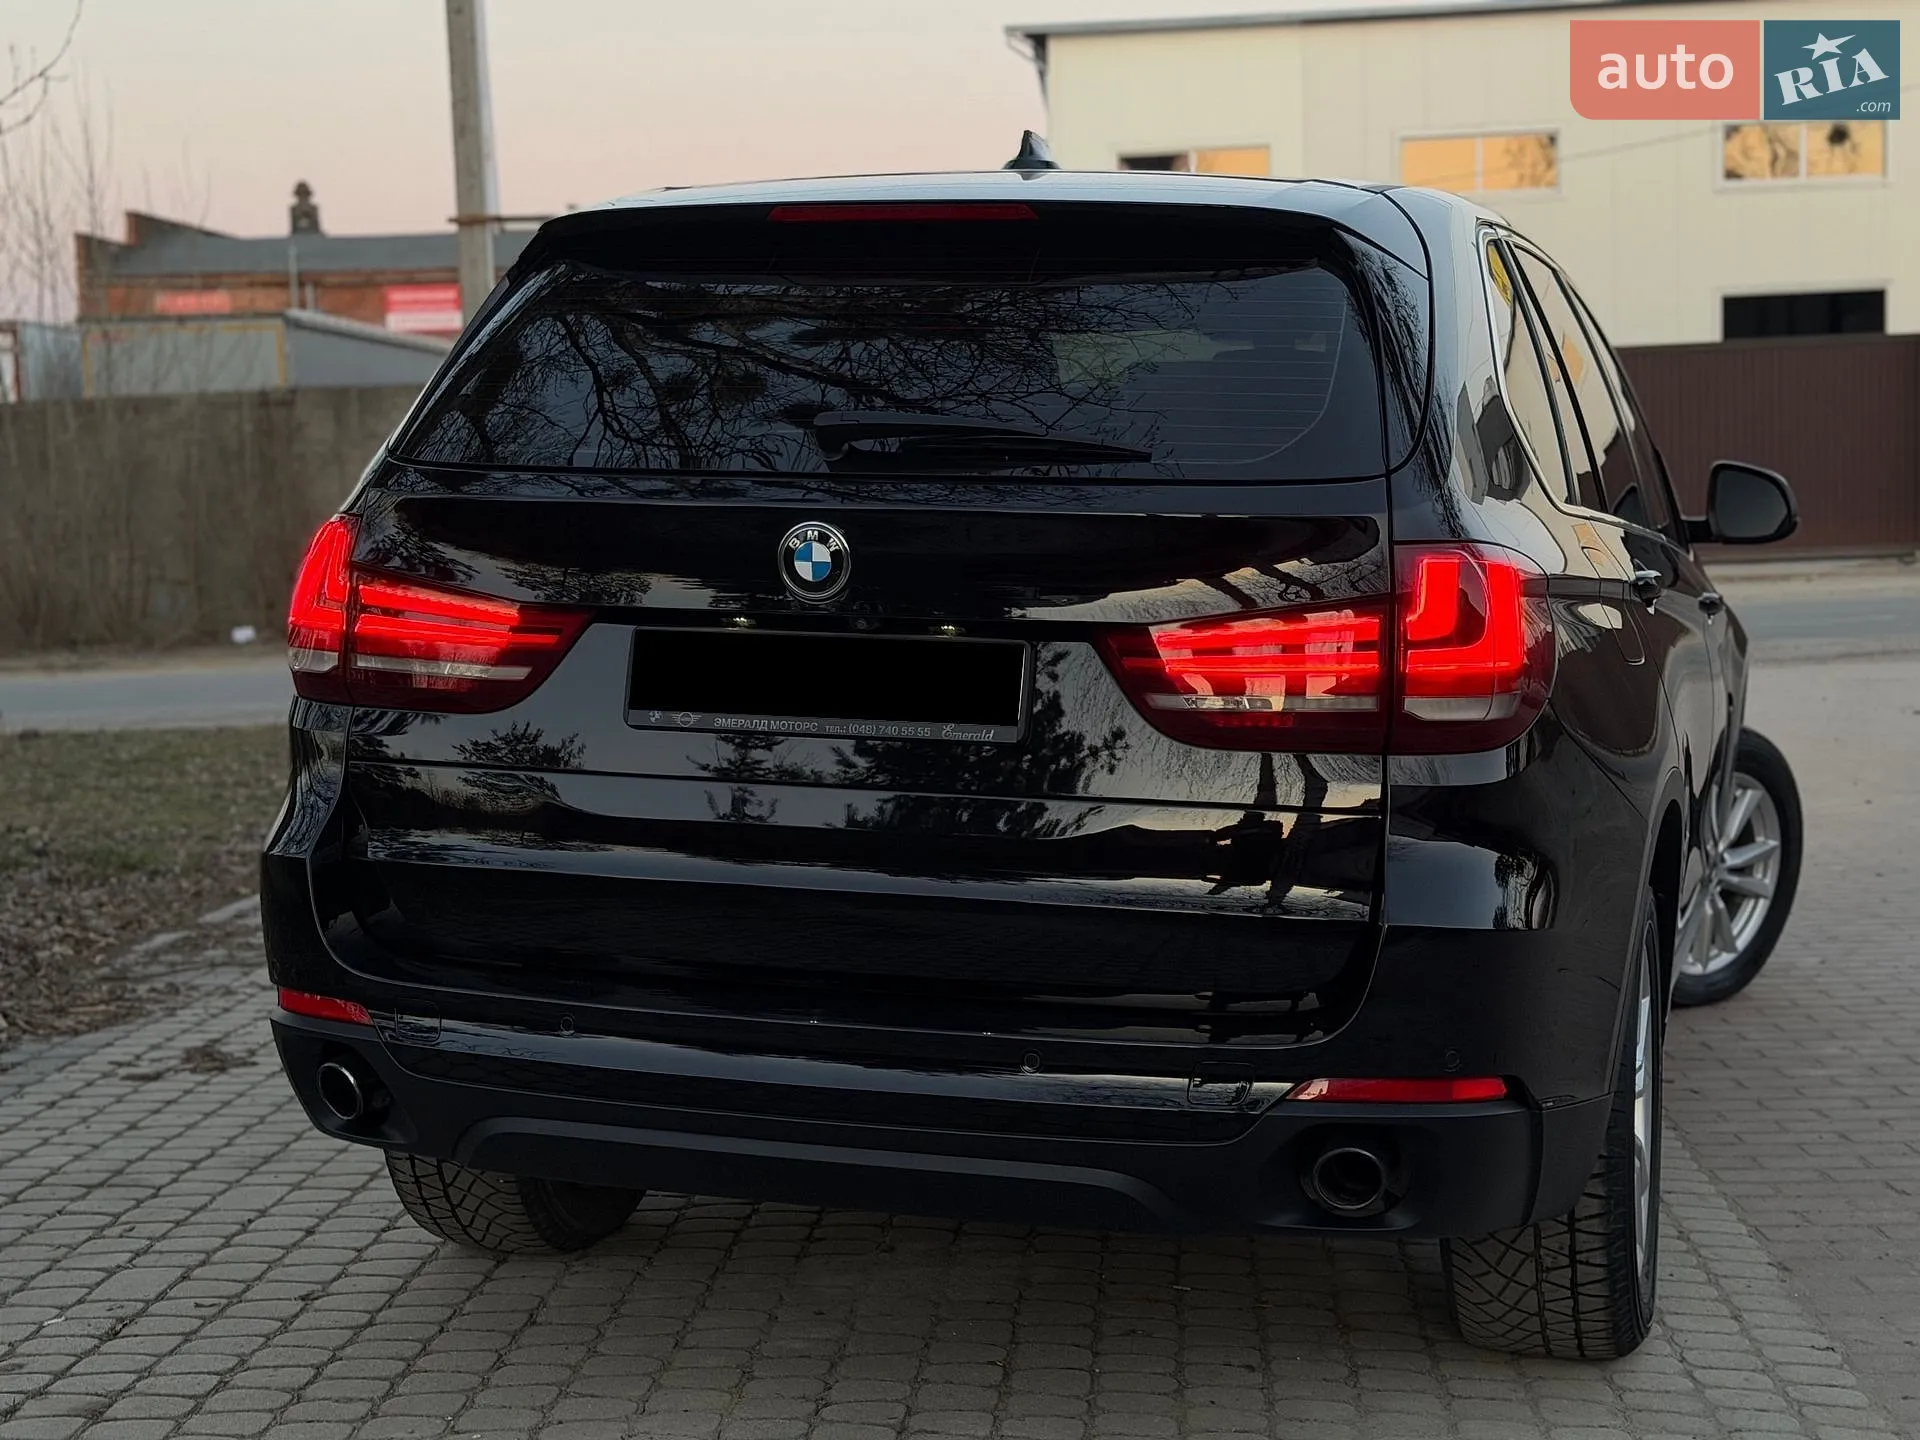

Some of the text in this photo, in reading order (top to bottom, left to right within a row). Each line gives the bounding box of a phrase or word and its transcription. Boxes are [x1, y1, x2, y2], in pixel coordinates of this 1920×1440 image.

[788, 530, 841, 552] BMW
[714, 717, 768, 731] ЭМЕРАЛД
[770, 719, 818, 732] МОТОРС
[879, 725, 899, 736] 740
[941, 723, 994, 742] Emerald
